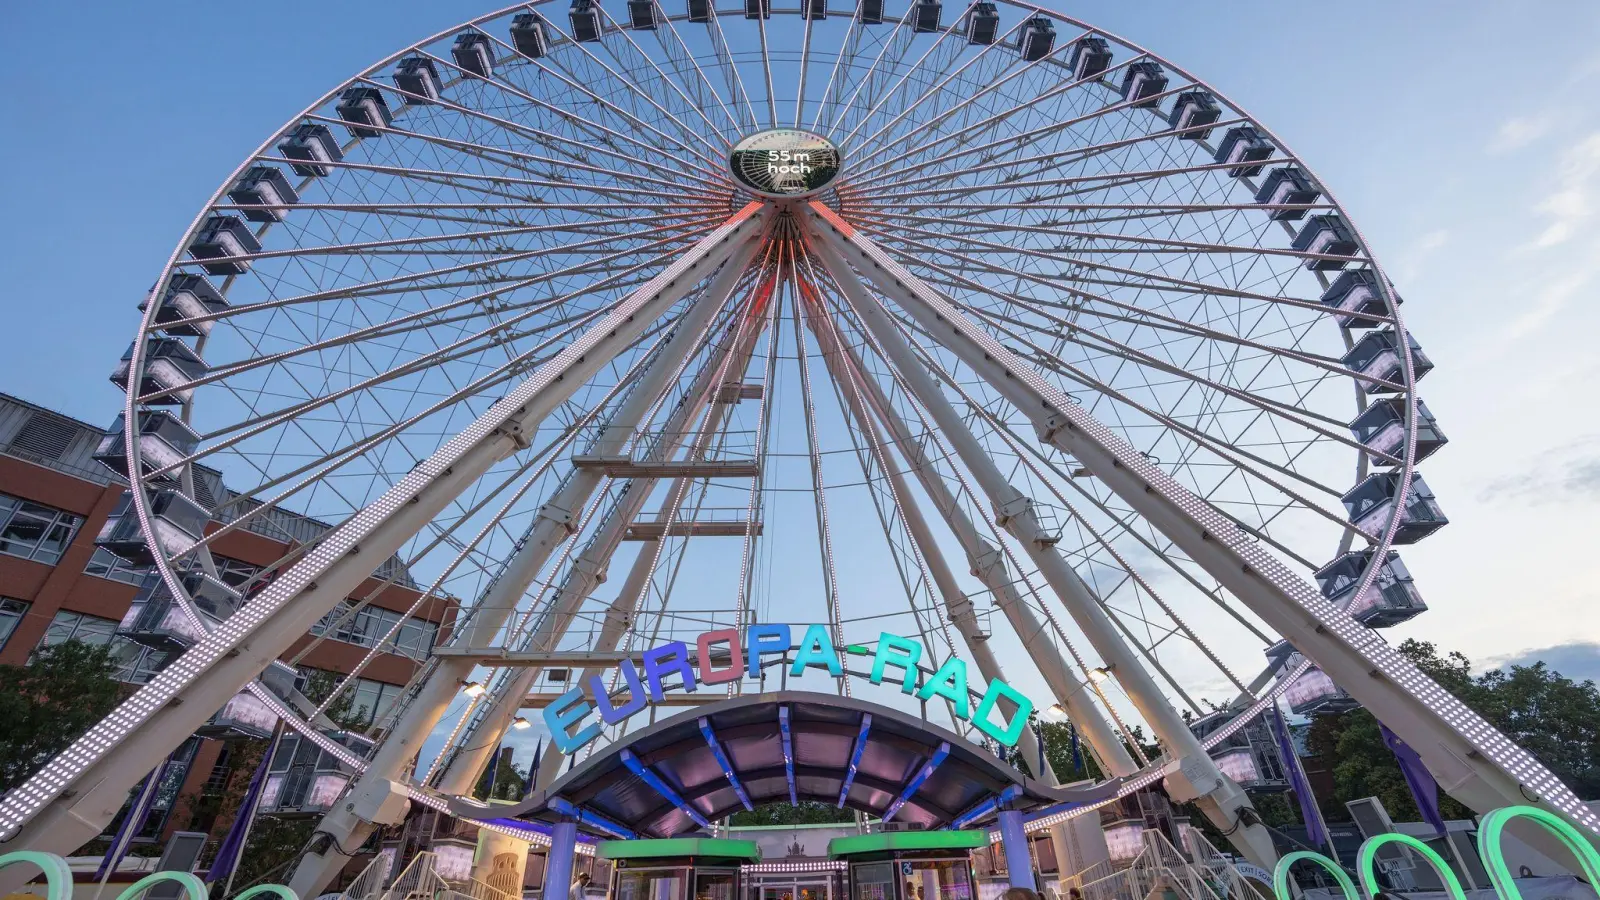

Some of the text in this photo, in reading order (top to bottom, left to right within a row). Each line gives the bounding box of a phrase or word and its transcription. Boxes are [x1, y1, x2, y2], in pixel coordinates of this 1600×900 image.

[768, 150, 790, 162] 55
[768, 163, 811, 174] hoch
[543, 624, 1034, 755] EUROPA-RAD
[1240, 866, 1254, 874] EXIT
